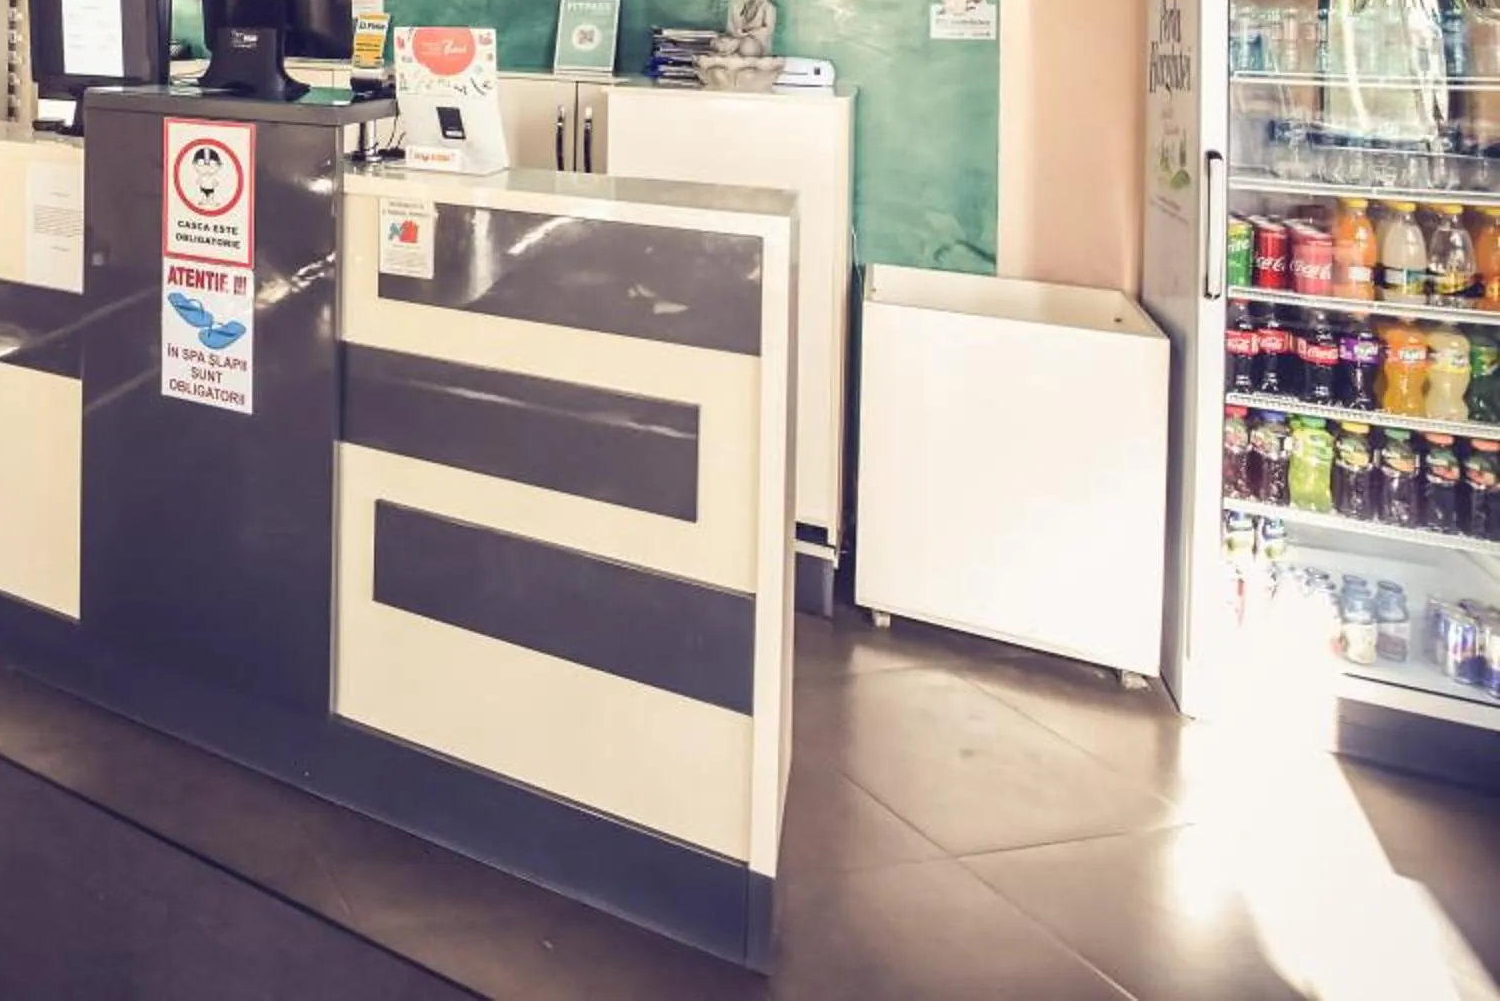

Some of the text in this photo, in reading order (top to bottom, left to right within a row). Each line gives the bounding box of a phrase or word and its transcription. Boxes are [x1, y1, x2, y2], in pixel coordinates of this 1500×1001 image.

[177, 220, 239, 235] CASCA ESTE
[175, 232, 241, 249] OBLIGATORIE
[182, 348, 205, 362] SPA
[191, 366, 222, 383] SUNT
[169, 378, 245, 406] OBLIGATORII
